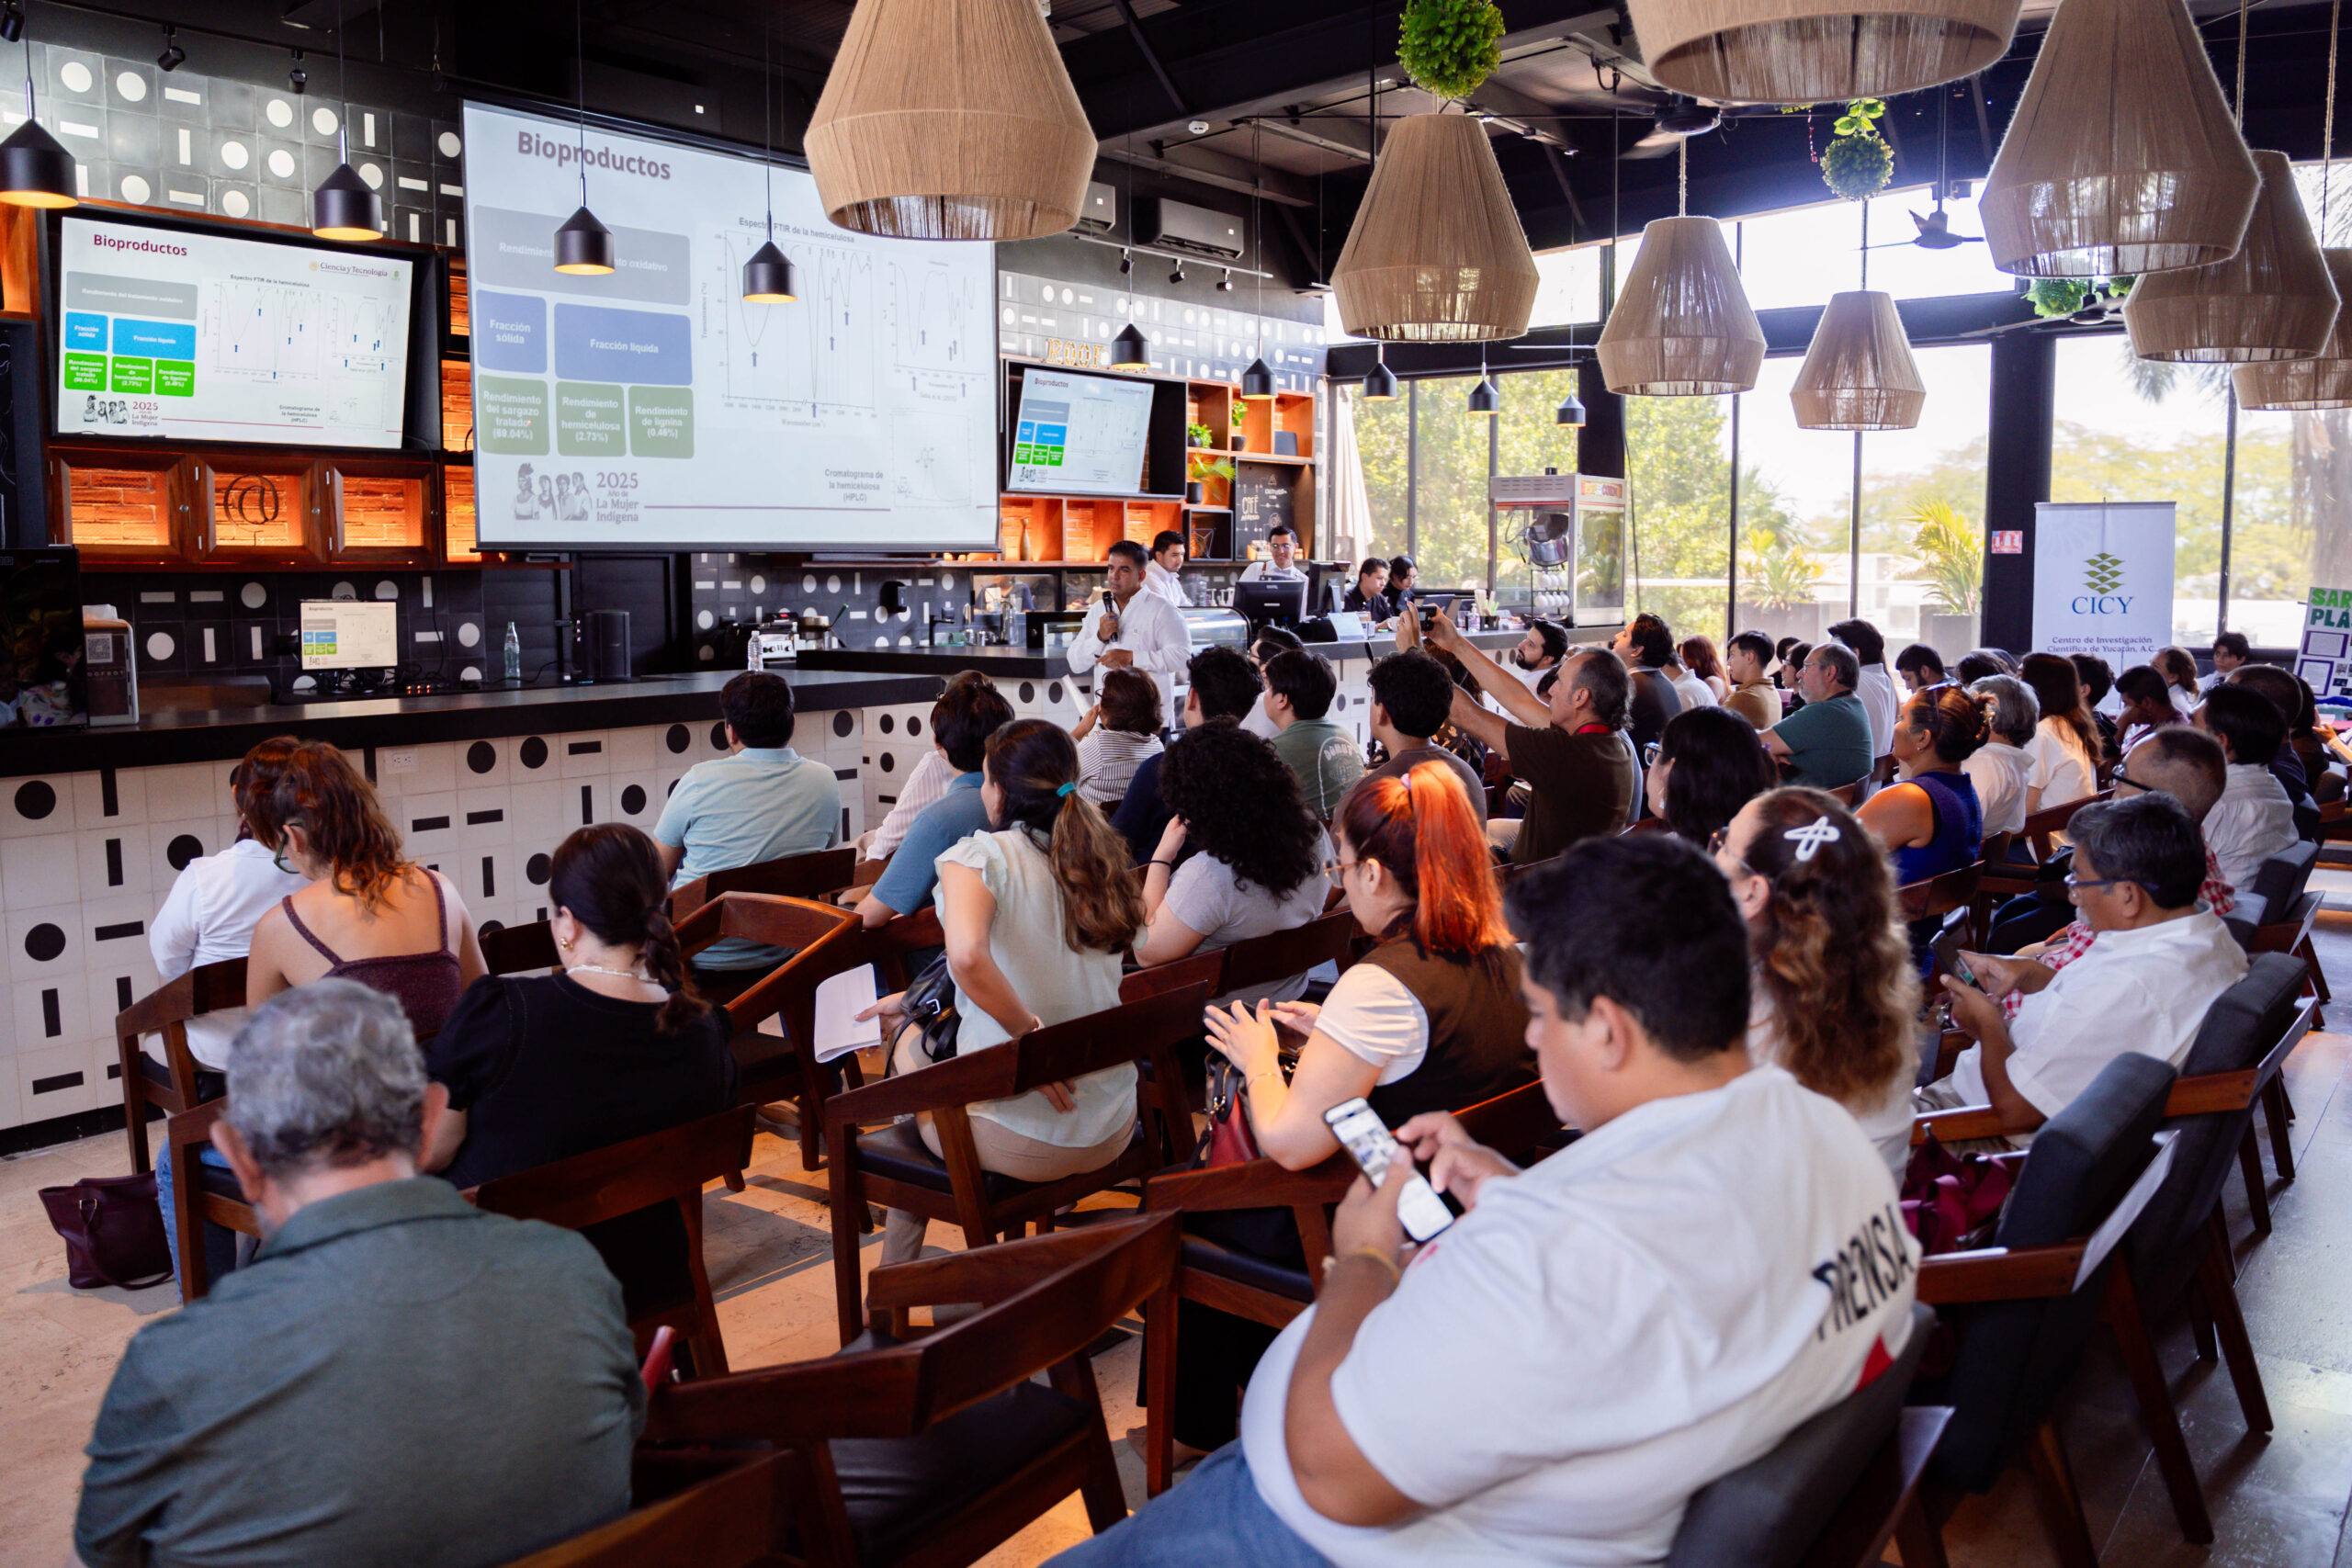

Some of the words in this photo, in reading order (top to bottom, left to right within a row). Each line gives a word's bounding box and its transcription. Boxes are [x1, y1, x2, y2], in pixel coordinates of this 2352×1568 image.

[518, 130, 672, 180] Bioproductos
[739, 217, 768, 229] Espectr
[774, 222, 790, 233] FTIR
[792, 226, 801, 234] de
[802, 229, 809, 237] la
[810, 230, 855, 243] hemicelulosa
[94, 234, 187, 256] Bioproductos
[499, 242, 555, 258] Rendimient
[320, 262, 346, 272] Ciencia
[628, 260, 668, 273] oxidativo
[490, 319, 531, 333] Fracción
[495, 331, 525, 344] sólida
[590, 338, 628, 352] Fracción
[483, 390, 542, 405] Rendimiento
[562, 396, 619, 410] Rendimiento
[132, 400, 159, 412] 2025
[486, 404, 501, 413] del
[502, 405, 539, 417] sargazo
[635, 405, 688, 417] Rendimiento
[585, 410, 597, 419] de
[495, 417, 529, 428] tratado
[561, 419, 621, 432] hemicelulosa
[641, 417, 653, 426] de
[654, 418, 683, 430] lignina
[575, 431, 609, 444] (2.73%)
[824, 468, 874, 479] Cromatograma
[875, 471, 884, 479] de
[596, 471, 639, 490] 2025
[829, 481, 835, 490] la
[836, 481, 880, 491] hemicelulosa
[842, 492, 867, 503] (HPLC)
[596, 498, 607, 510] La
[611, 498, 639, 513] Mujer
[2071, 596, 2135, 615] CICY
[2097, 637, 2153, 645] Investigación
[1812, 1203, 1915, 1341] PRENSA
